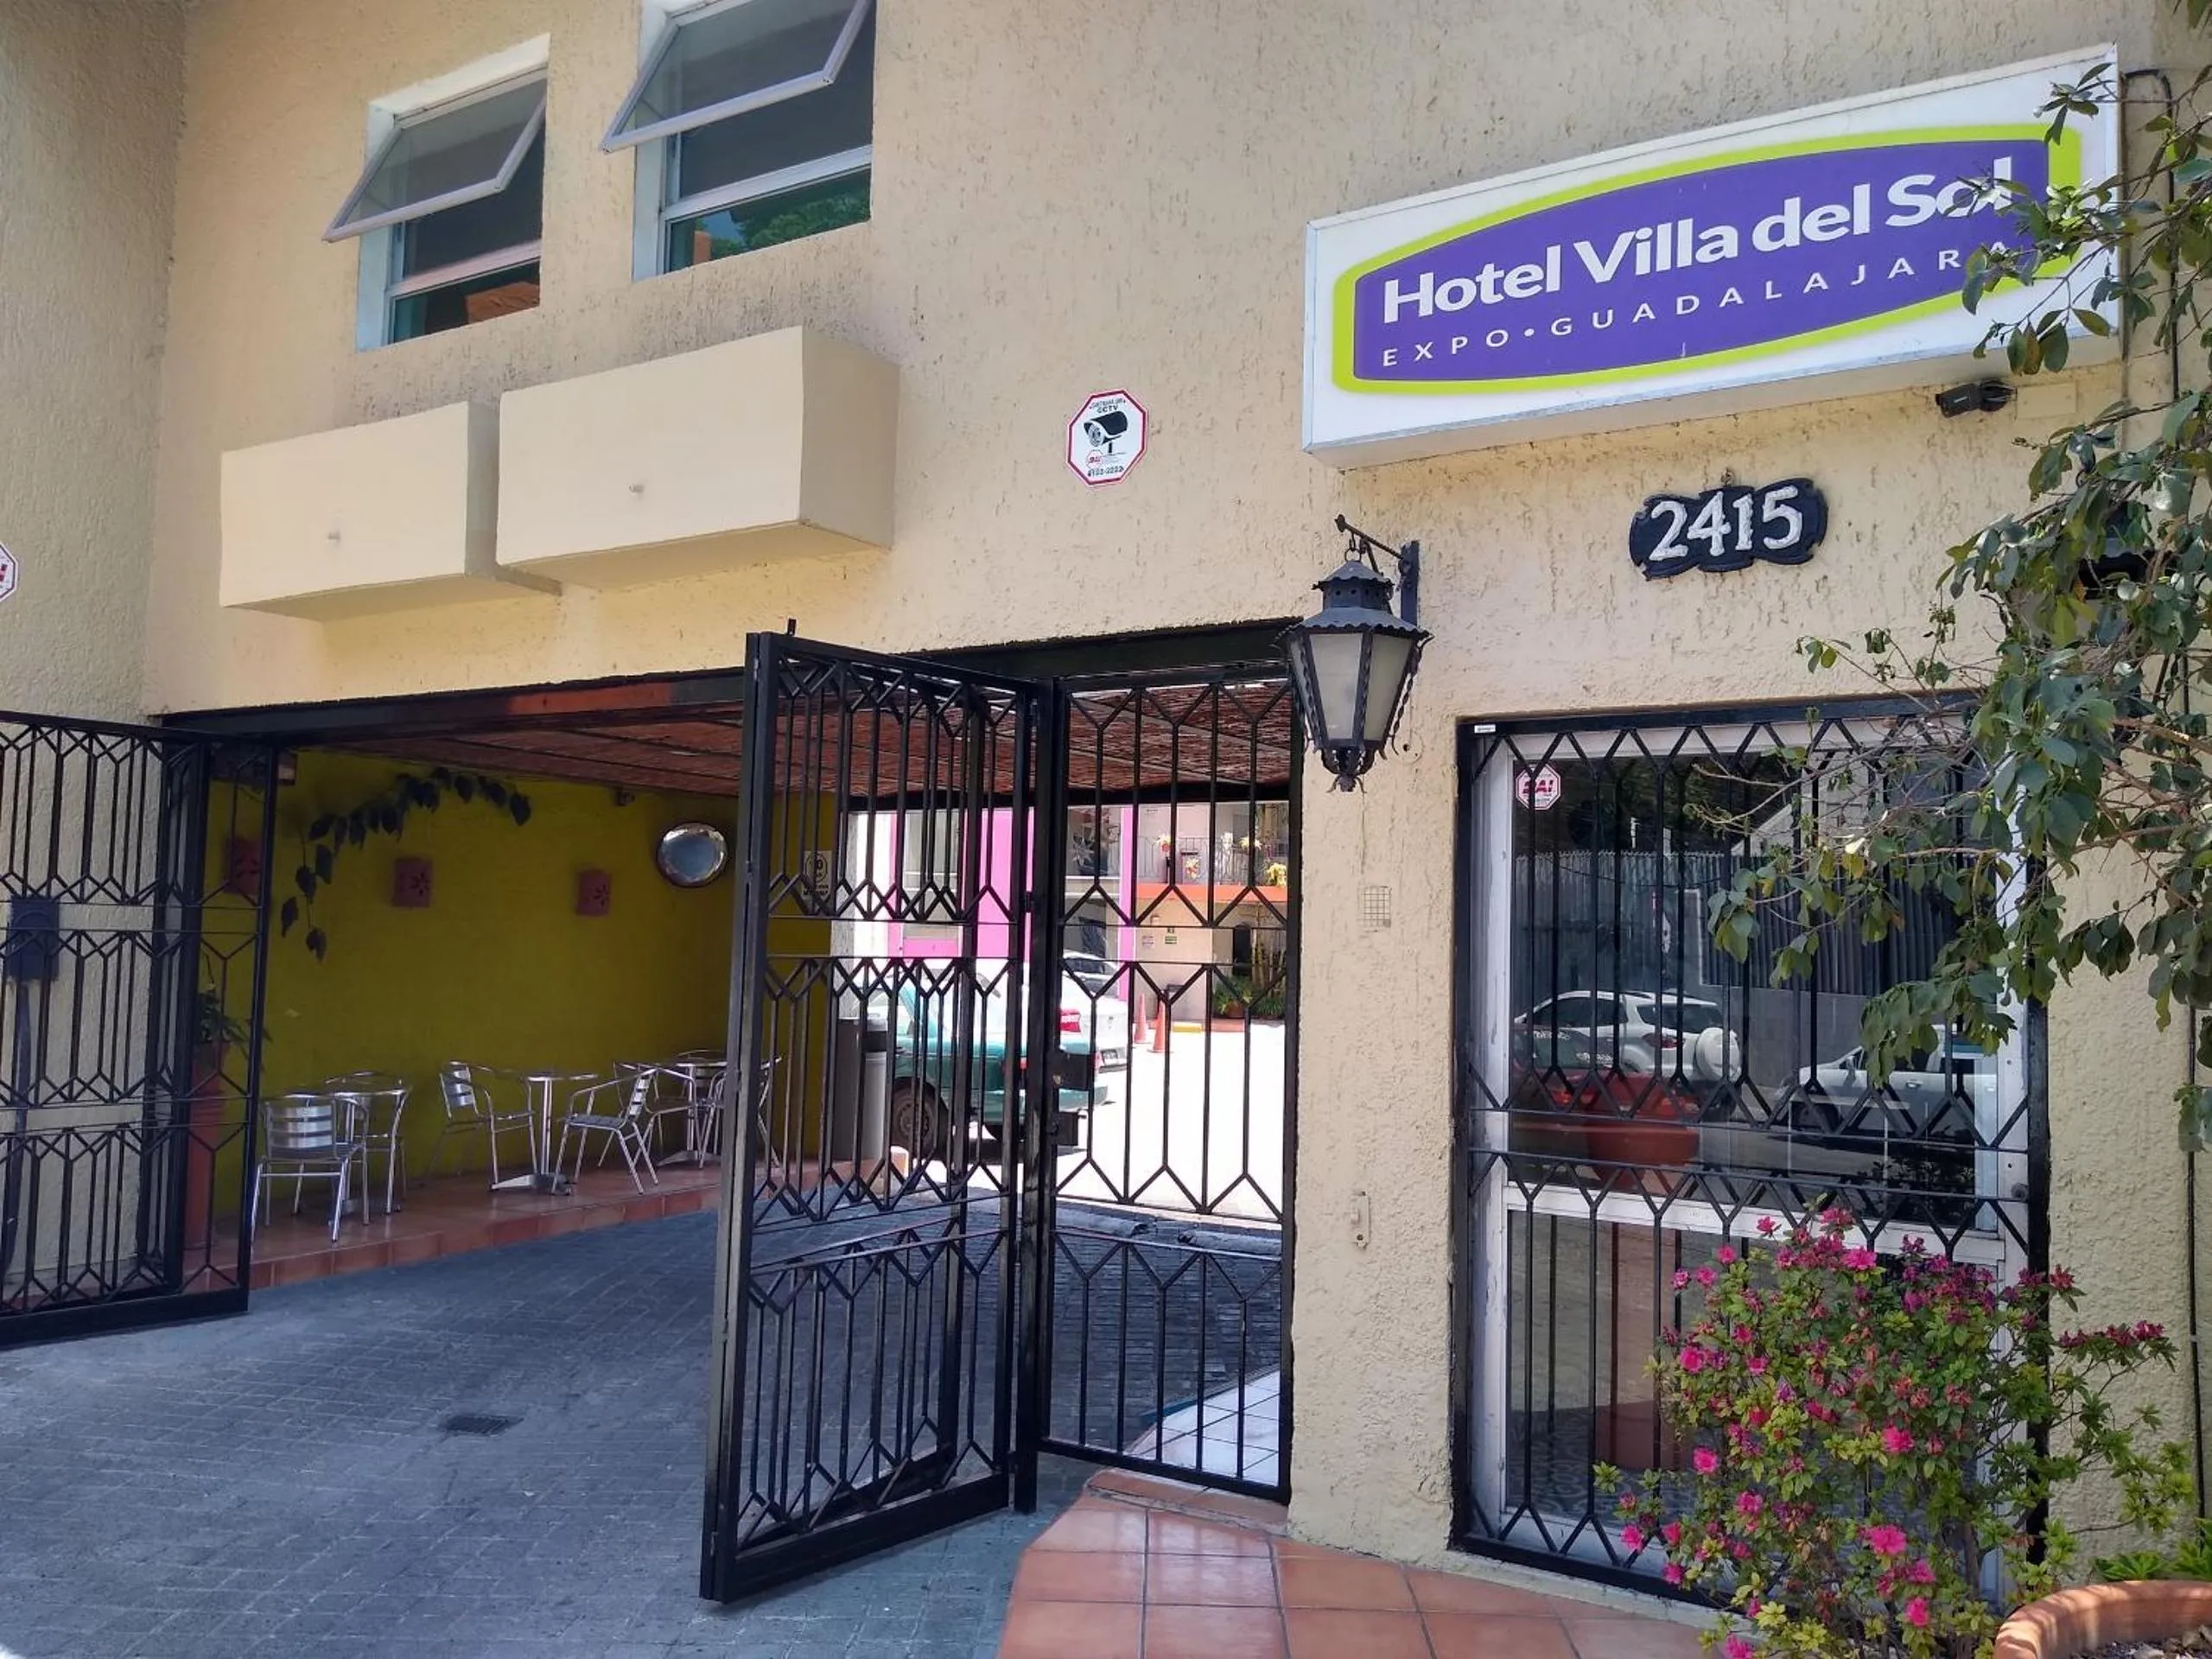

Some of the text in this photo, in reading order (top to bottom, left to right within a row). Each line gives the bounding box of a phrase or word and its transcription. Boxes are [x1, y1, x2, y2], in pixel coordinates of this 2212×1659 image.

[1383, 156, 2012, 324] Hotel Villa del Sol
[1382, 329, 1509, 367] EXPO
[1649, 485, 1803, 562] 2415
